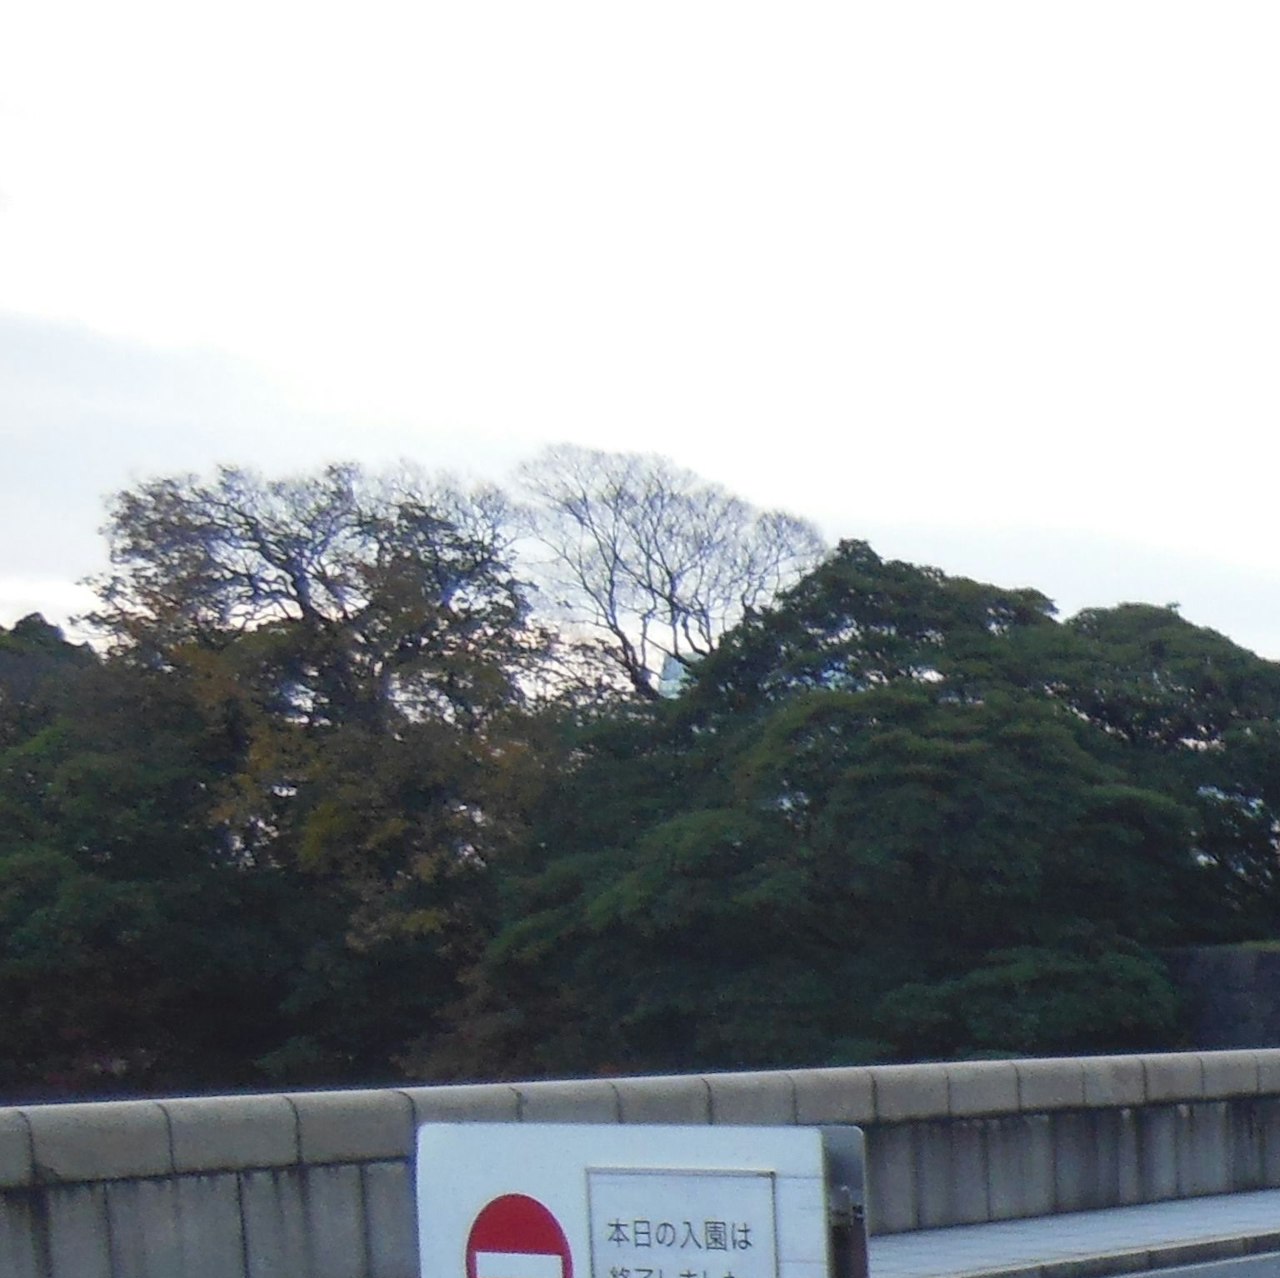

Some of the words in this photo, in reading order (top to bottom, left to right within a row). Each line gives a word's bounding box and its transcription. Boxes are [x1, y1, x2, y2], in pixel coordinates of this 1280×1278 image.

[607, 1217, 753, 1251] 本日の入園は
